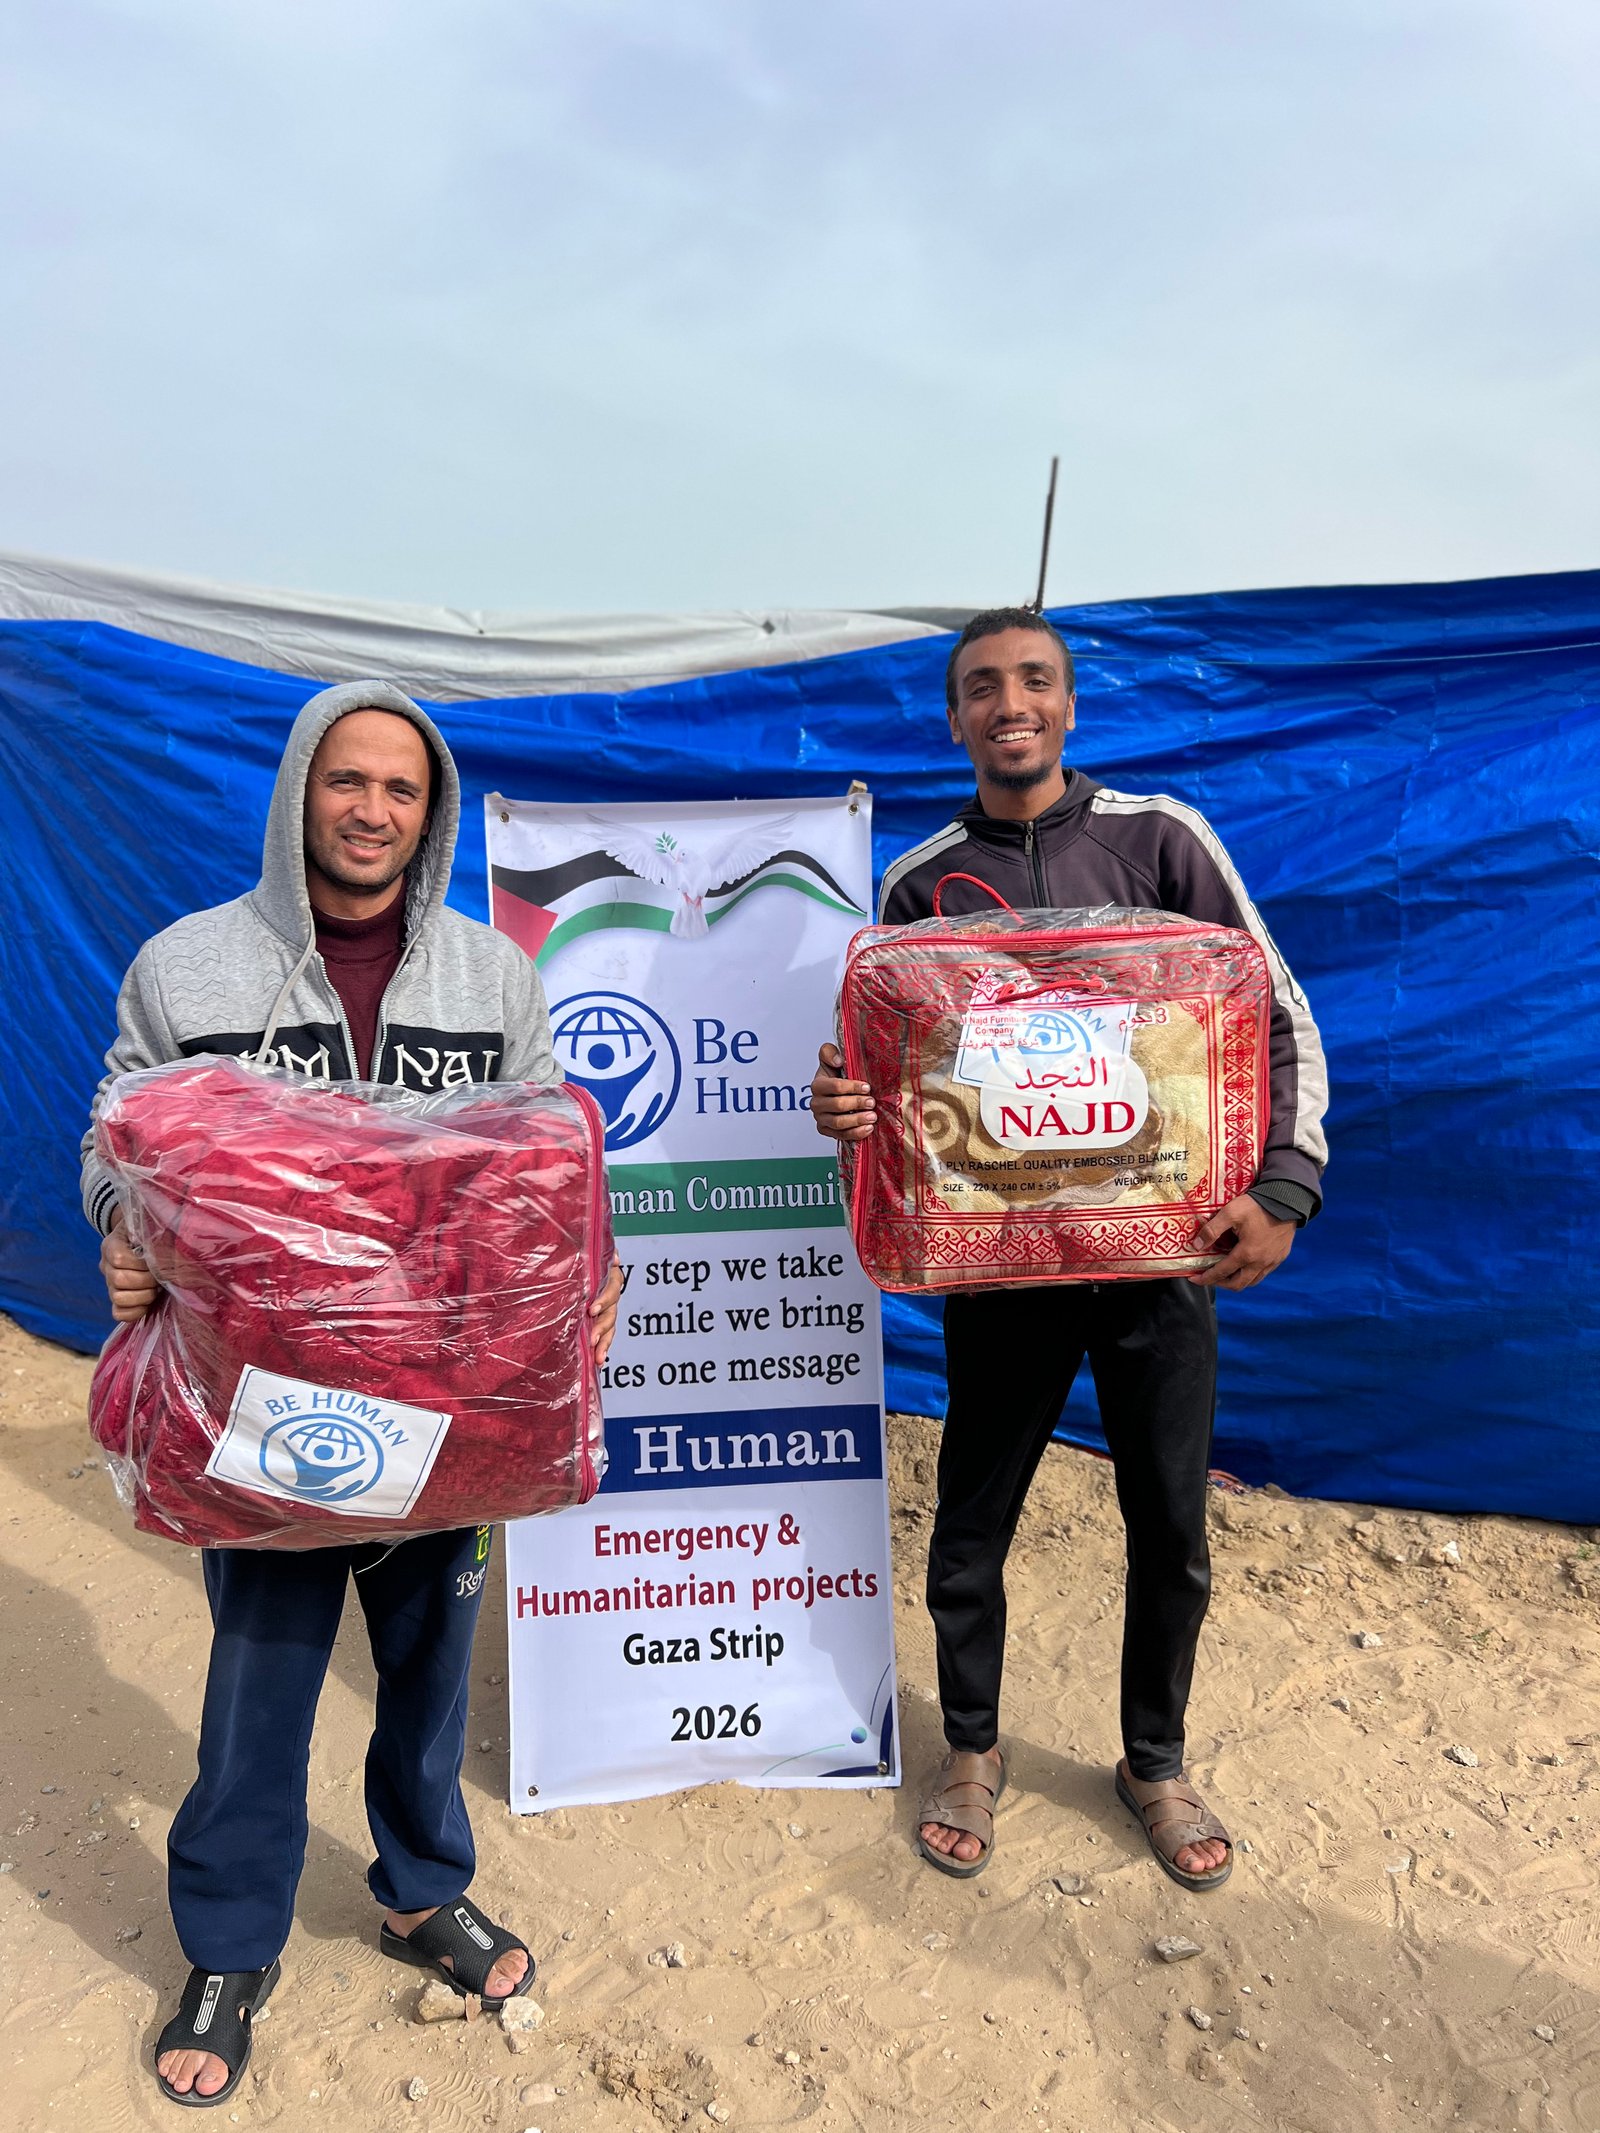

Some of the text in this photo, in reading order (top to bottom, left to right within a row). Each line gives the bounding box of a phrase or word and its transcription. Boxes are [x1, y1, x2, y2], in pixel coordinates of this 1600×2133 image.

[969, 1016, 988, 1025] Najd
[975, 1026, 1014, 1038] Company
[1156, 1007, 1167, 1024] 3
[692, 1018, 759, 1064] Be
[1015, 1056, 1107, 1099] النجد
[998, 1101, 1135, 1138] NAJD
[946, 1161, 965, 1171] PLY
[968, 1160, 1020, 1171] RASCHEL
[1023, 1158, 1069, 1170] QUALITY
[1074, 1154, 1135, 1168] EMBOSSED
[1138, 1151, 1189, 1164] BLANKET
[1114, 1175, 1155, 1186] WEIGHT:
[1173, 1172, 1188, 1181] KG
[943, 1183, 964, 1192] SIZE
[973, 1183, 989, 1192] 220
[992, 1183, 998, 1191] X
[1001, 1183, 1017, 1191] 240
[1020, 1182, 1036, 1191] CM
[1046, 1181, 1060, 1190] 5%
[646, 1257, 711, 1291] step
[721, 1256, 767, 1281] we
[777, 1246, 844, 1280] take
[628, 1294, 865, 1337] smile we bring
[600, 1352, 861, 1389] ies one message
[264, 1391, 409, 1447] BE HUMAN
[633, 1424, 861, 1475] Human
[594, 1513, 801, 1560] Emergency &
[516, 1566, 878, 1619] Humanitarian projects
[623, 1624, 785, 1667] Gaza Strip
[671, 1702, 763, 1743] 2026
